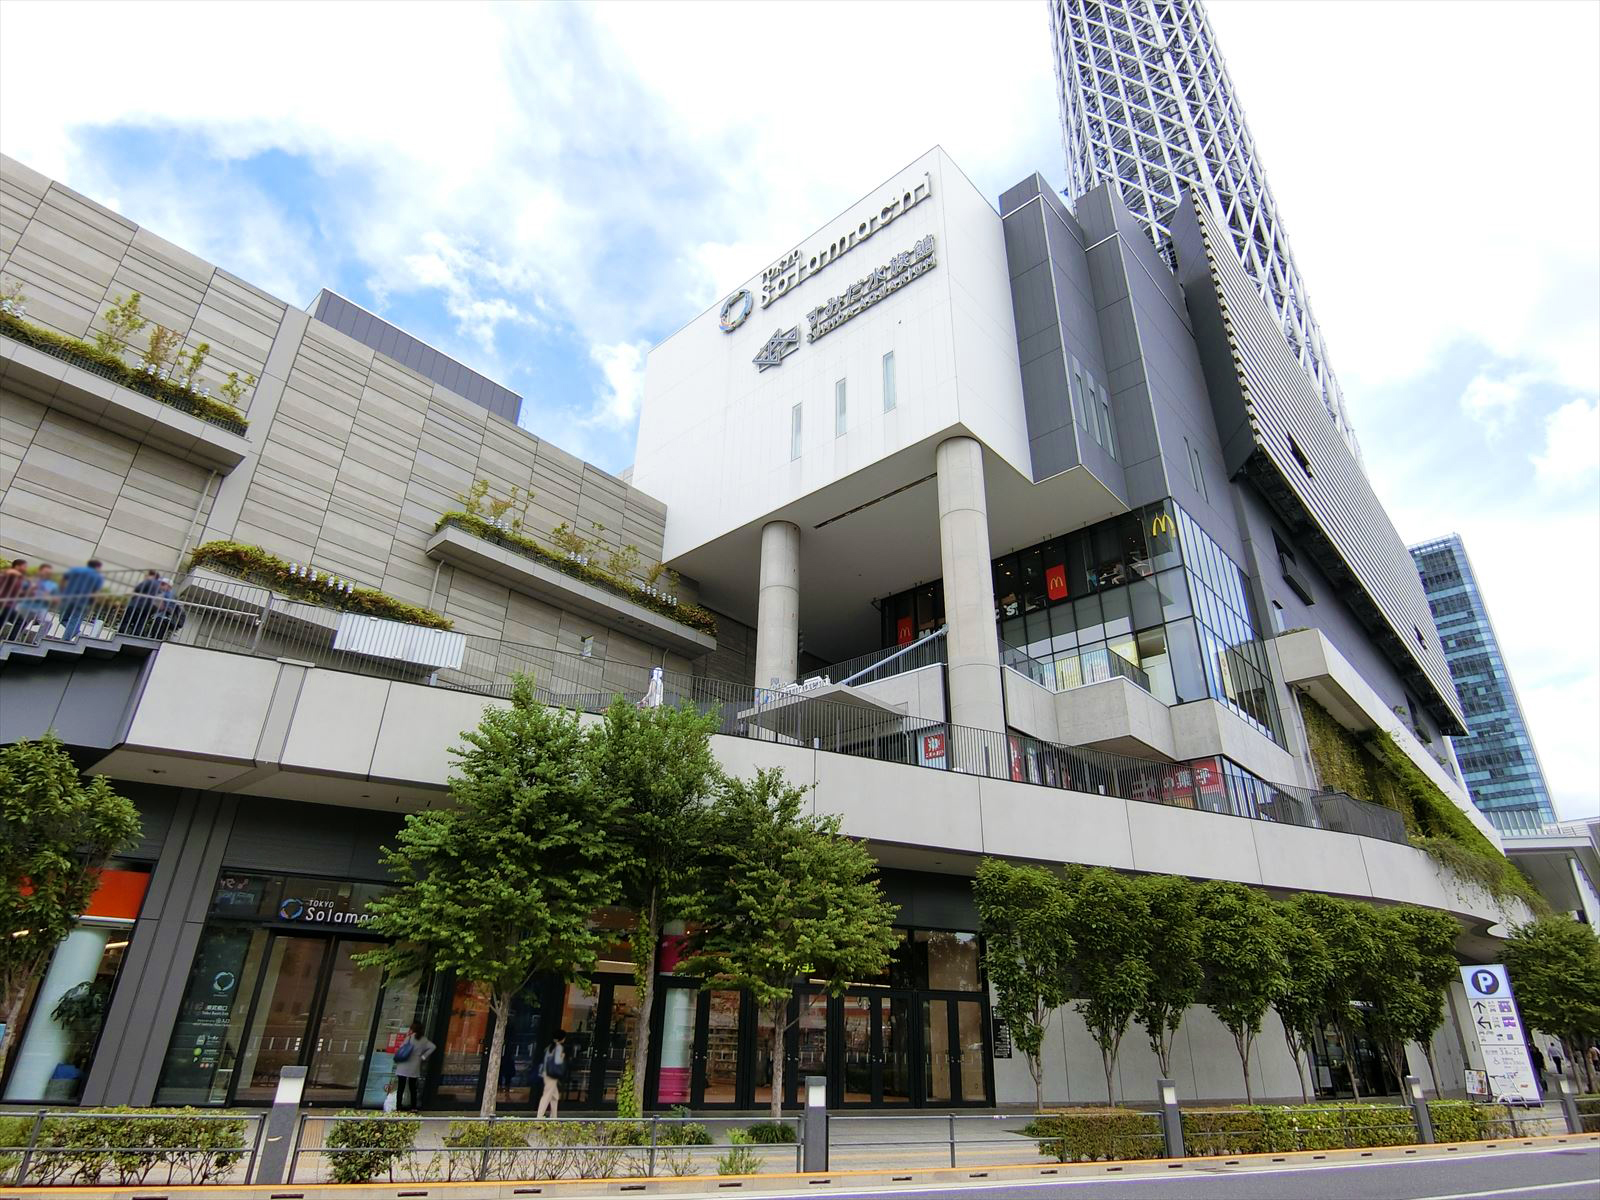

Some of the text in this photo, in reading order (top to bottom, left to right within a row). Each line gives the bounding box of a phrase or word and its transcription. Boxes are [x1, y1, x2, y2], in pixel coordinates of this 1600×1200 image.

[760, 171, 932, 310] Solamachi
[806, 234, 935, 330] すみだ水族館
[308, 900, 335, 908] TOKYO
[305, 906, 385, 924] Solama
[1477, 972, 1493, 992] P
